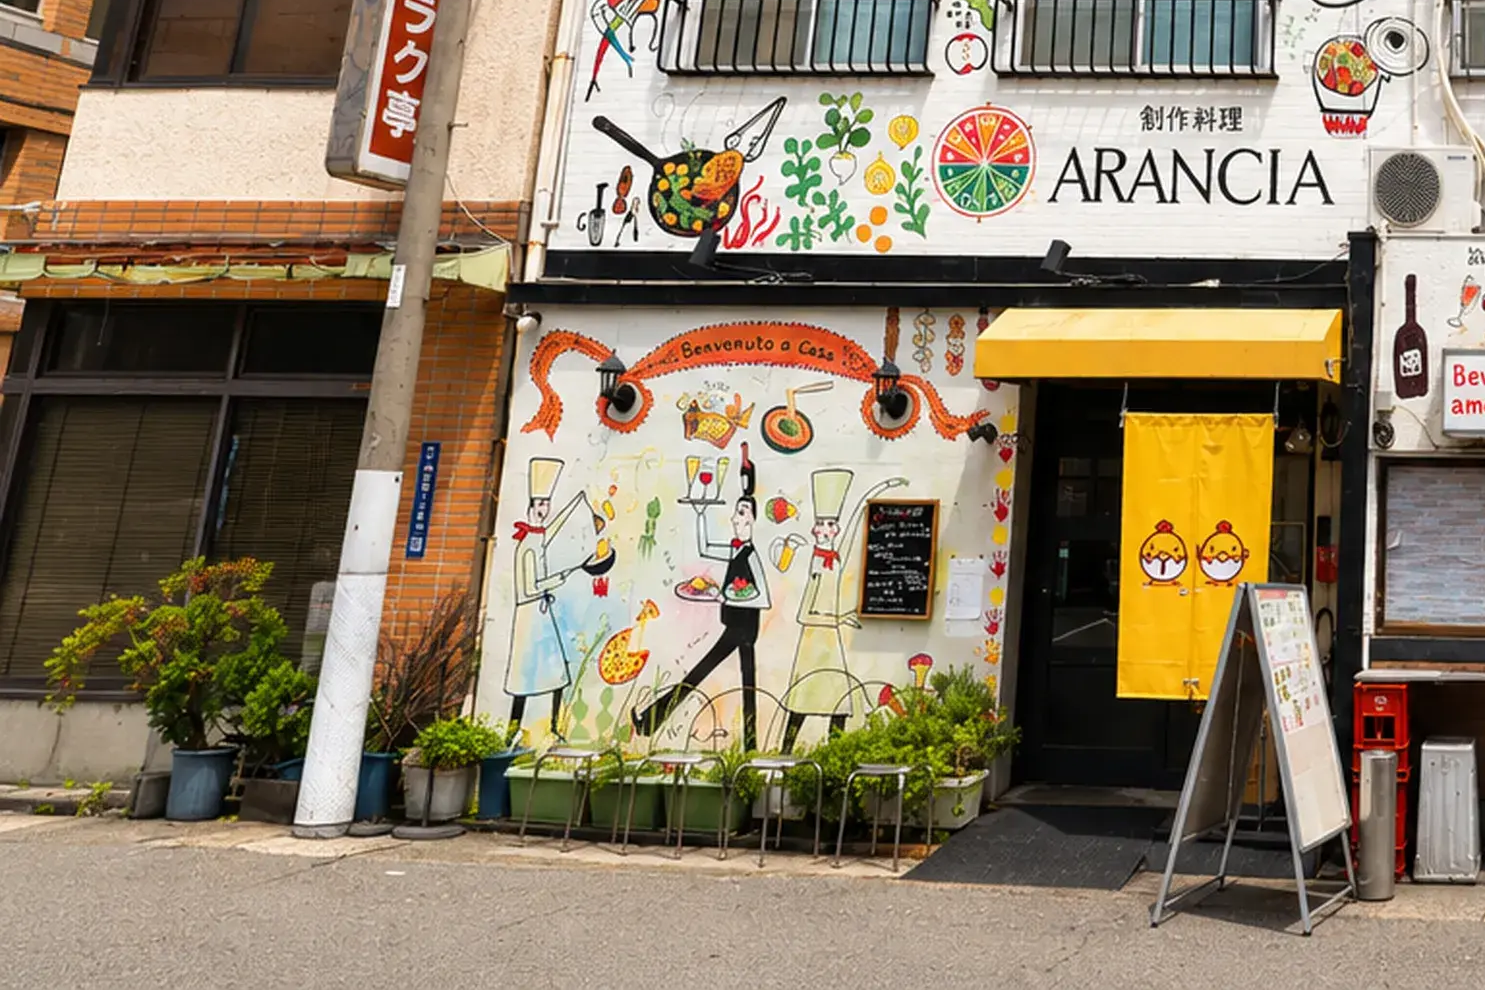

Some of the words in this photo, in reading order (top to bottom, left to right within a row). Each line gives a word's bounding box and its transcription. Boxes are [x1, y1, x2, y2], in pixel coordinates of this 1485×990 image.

[1140, 105, 1244, 132] 創作料理
[1047, 146, 1336, 206] ARANCIA
